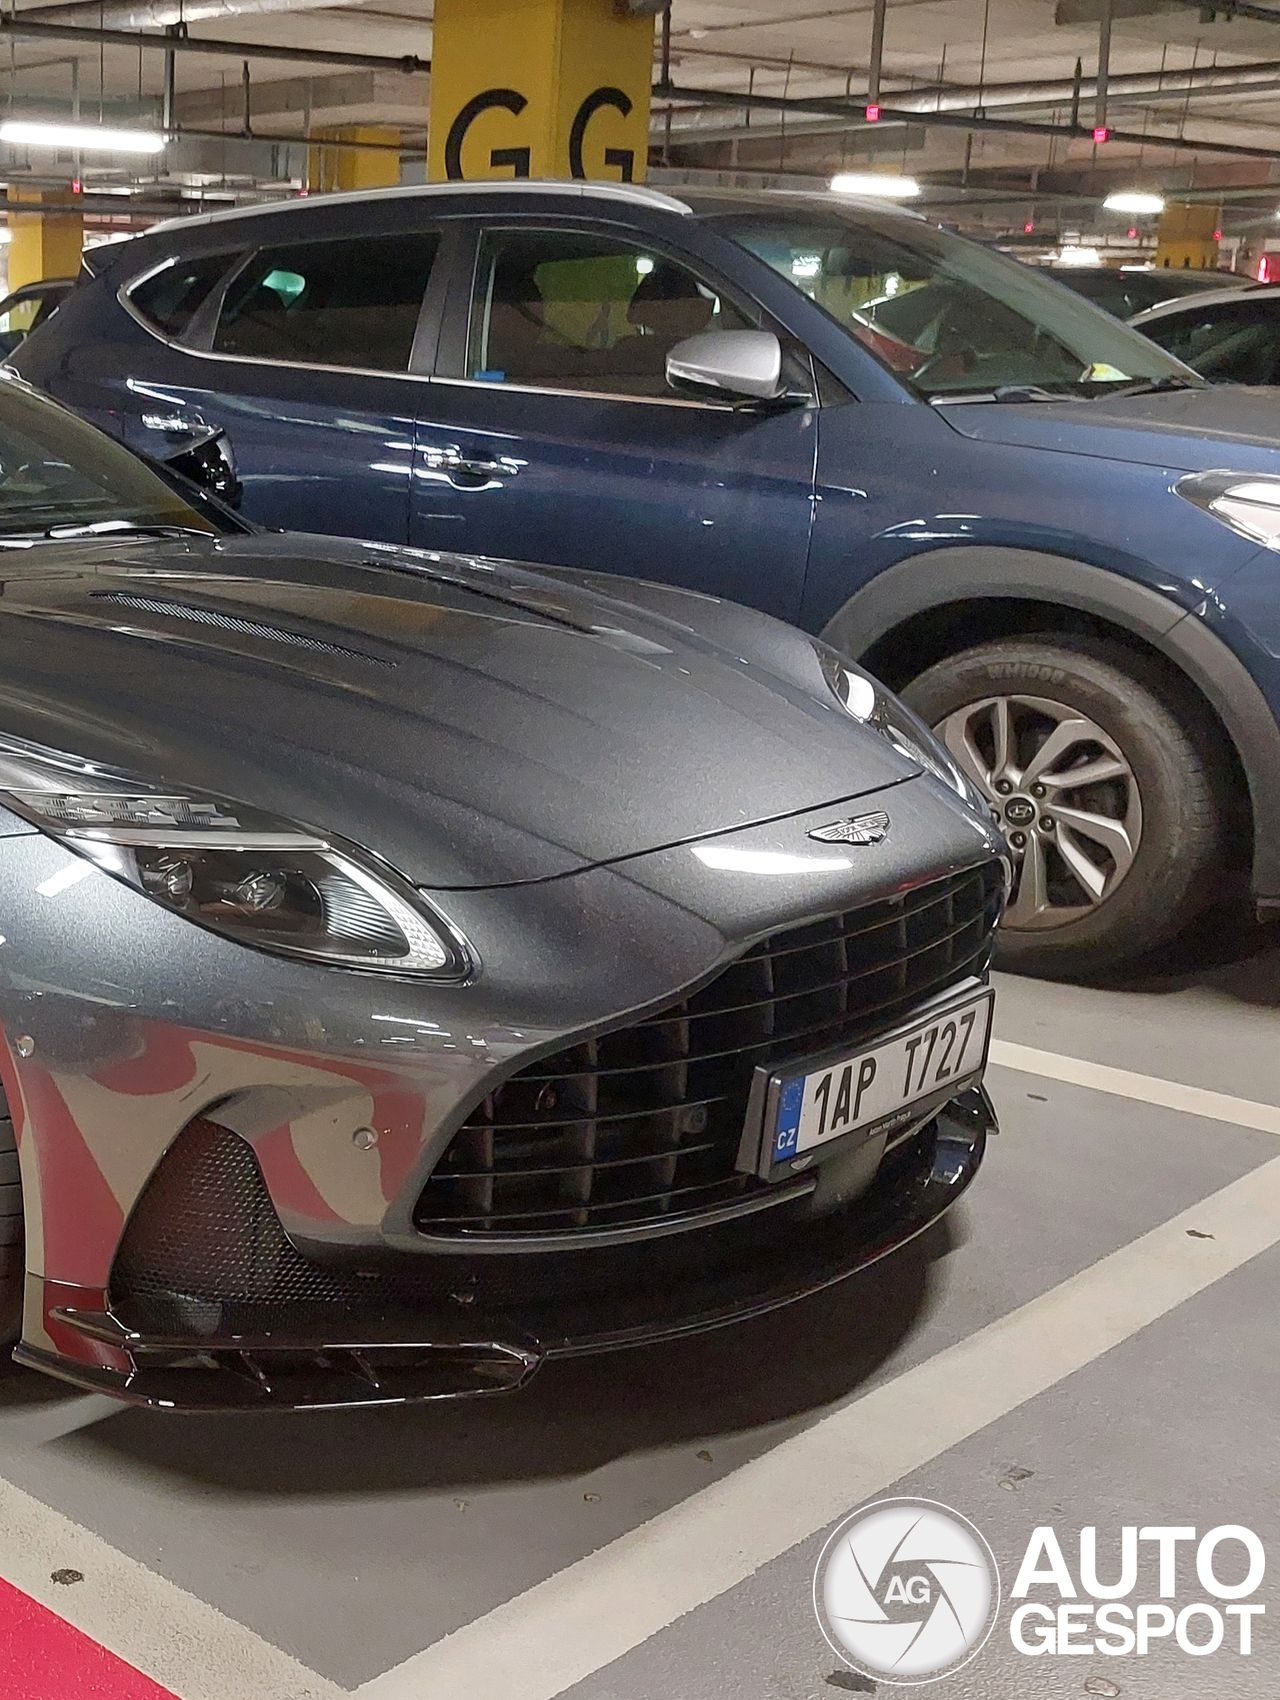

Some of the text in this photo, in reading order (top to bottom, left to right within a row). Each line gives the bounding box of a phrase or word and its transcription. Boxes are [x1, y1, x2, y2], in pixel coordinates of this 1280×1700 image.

[445, 88, 530, 179] G
[570, 87, 634, 181] G
[814, 1010, 976, 1135] 1AP T727
[777, 1127, 796, 1150] CZ
